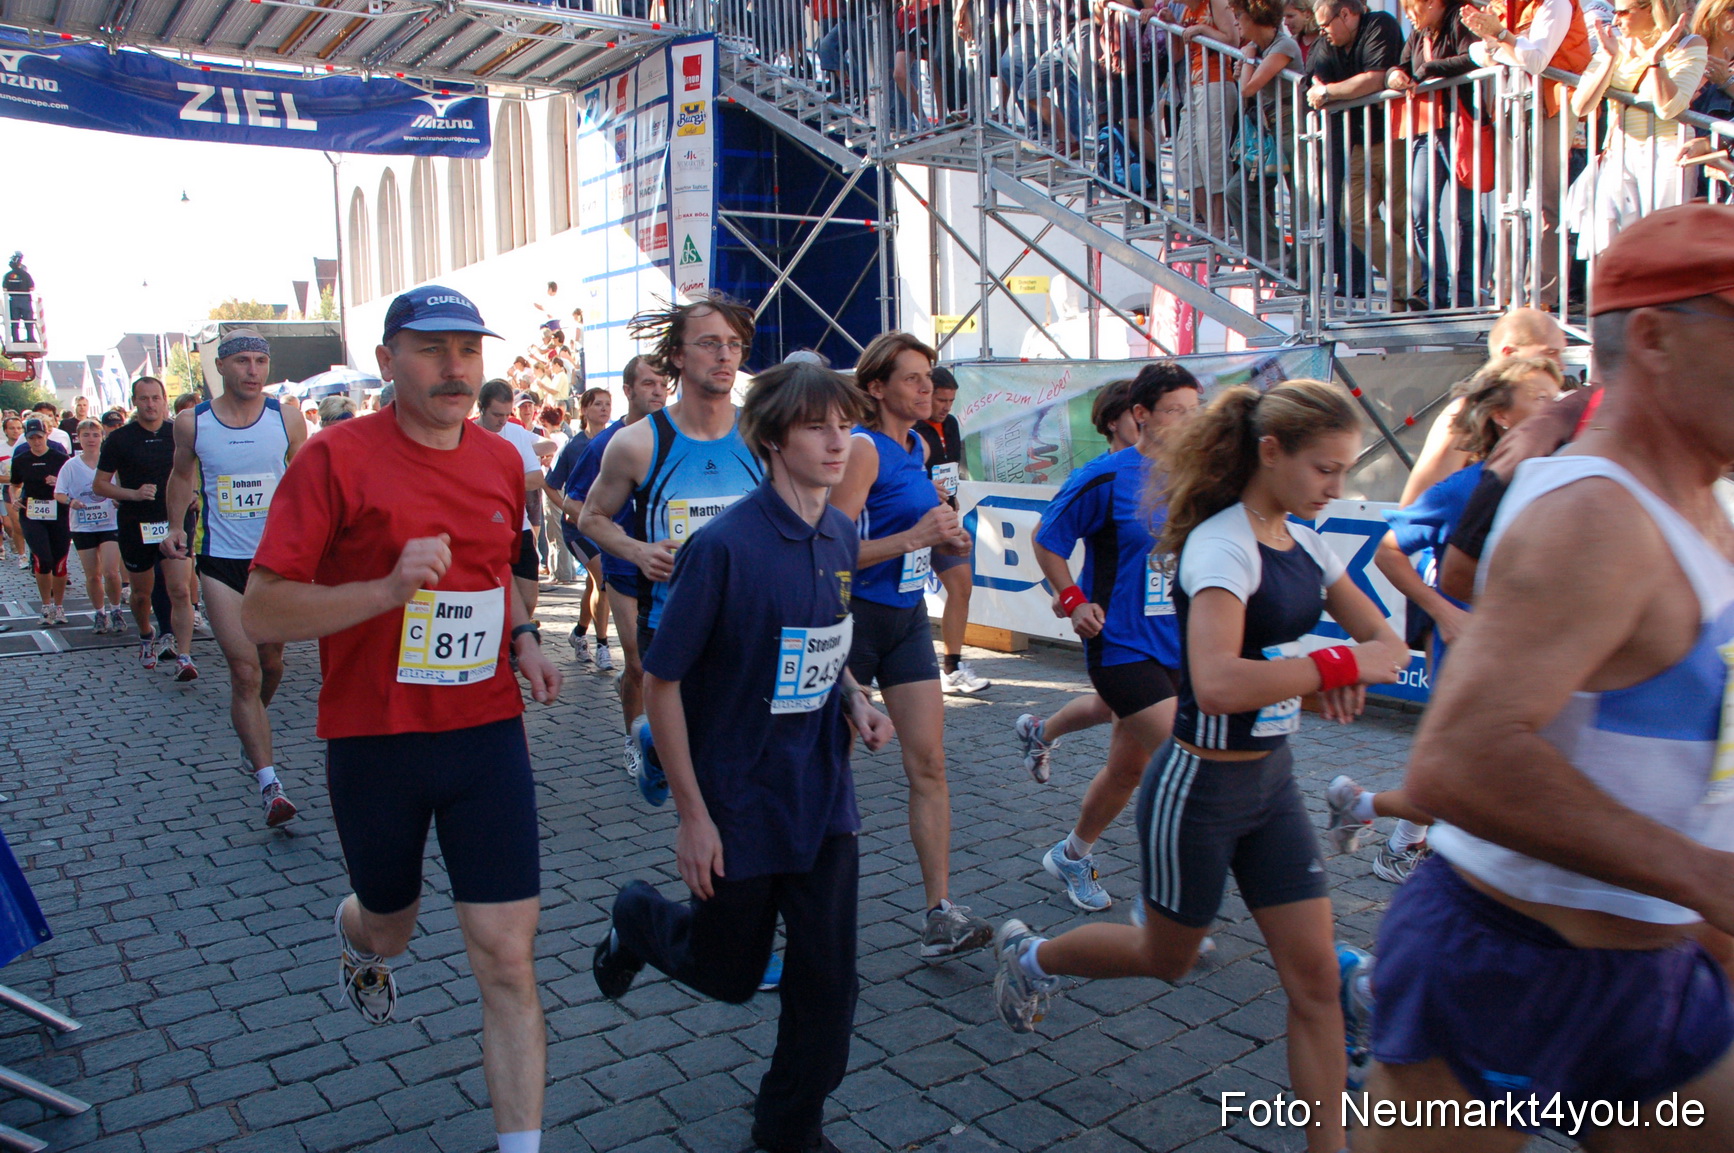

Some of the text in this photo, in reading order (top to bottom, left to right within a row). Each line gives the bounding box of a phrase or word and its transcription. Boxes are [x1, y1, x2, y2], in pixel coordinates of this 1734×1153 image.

[0, 72, 59, 93] IZUNO
[177, 82, 317, 131] ZIEL
[411, 114, 474, 130] MIZUNO
[1006, 392, 1032, 405] zum
[1037, 369, 1071, 405] Leben
[232, 480, 262, 488] Johann
[221, 492, 228, 500] B
[235, 493, 263, 507] 147
[34, 507, 50, 515] 246
[86, 511, 108, 521] 2323
[690, 504, 727, 517] Matthi
[674, 524, 683, 534] C
[1150, 577, 1159, 587] C
[436, 602, 473, 619] Arno
[410, 625, 423, 640] C
[434, 631, 486, 659] 817
[784, 661, 795, 674] B
